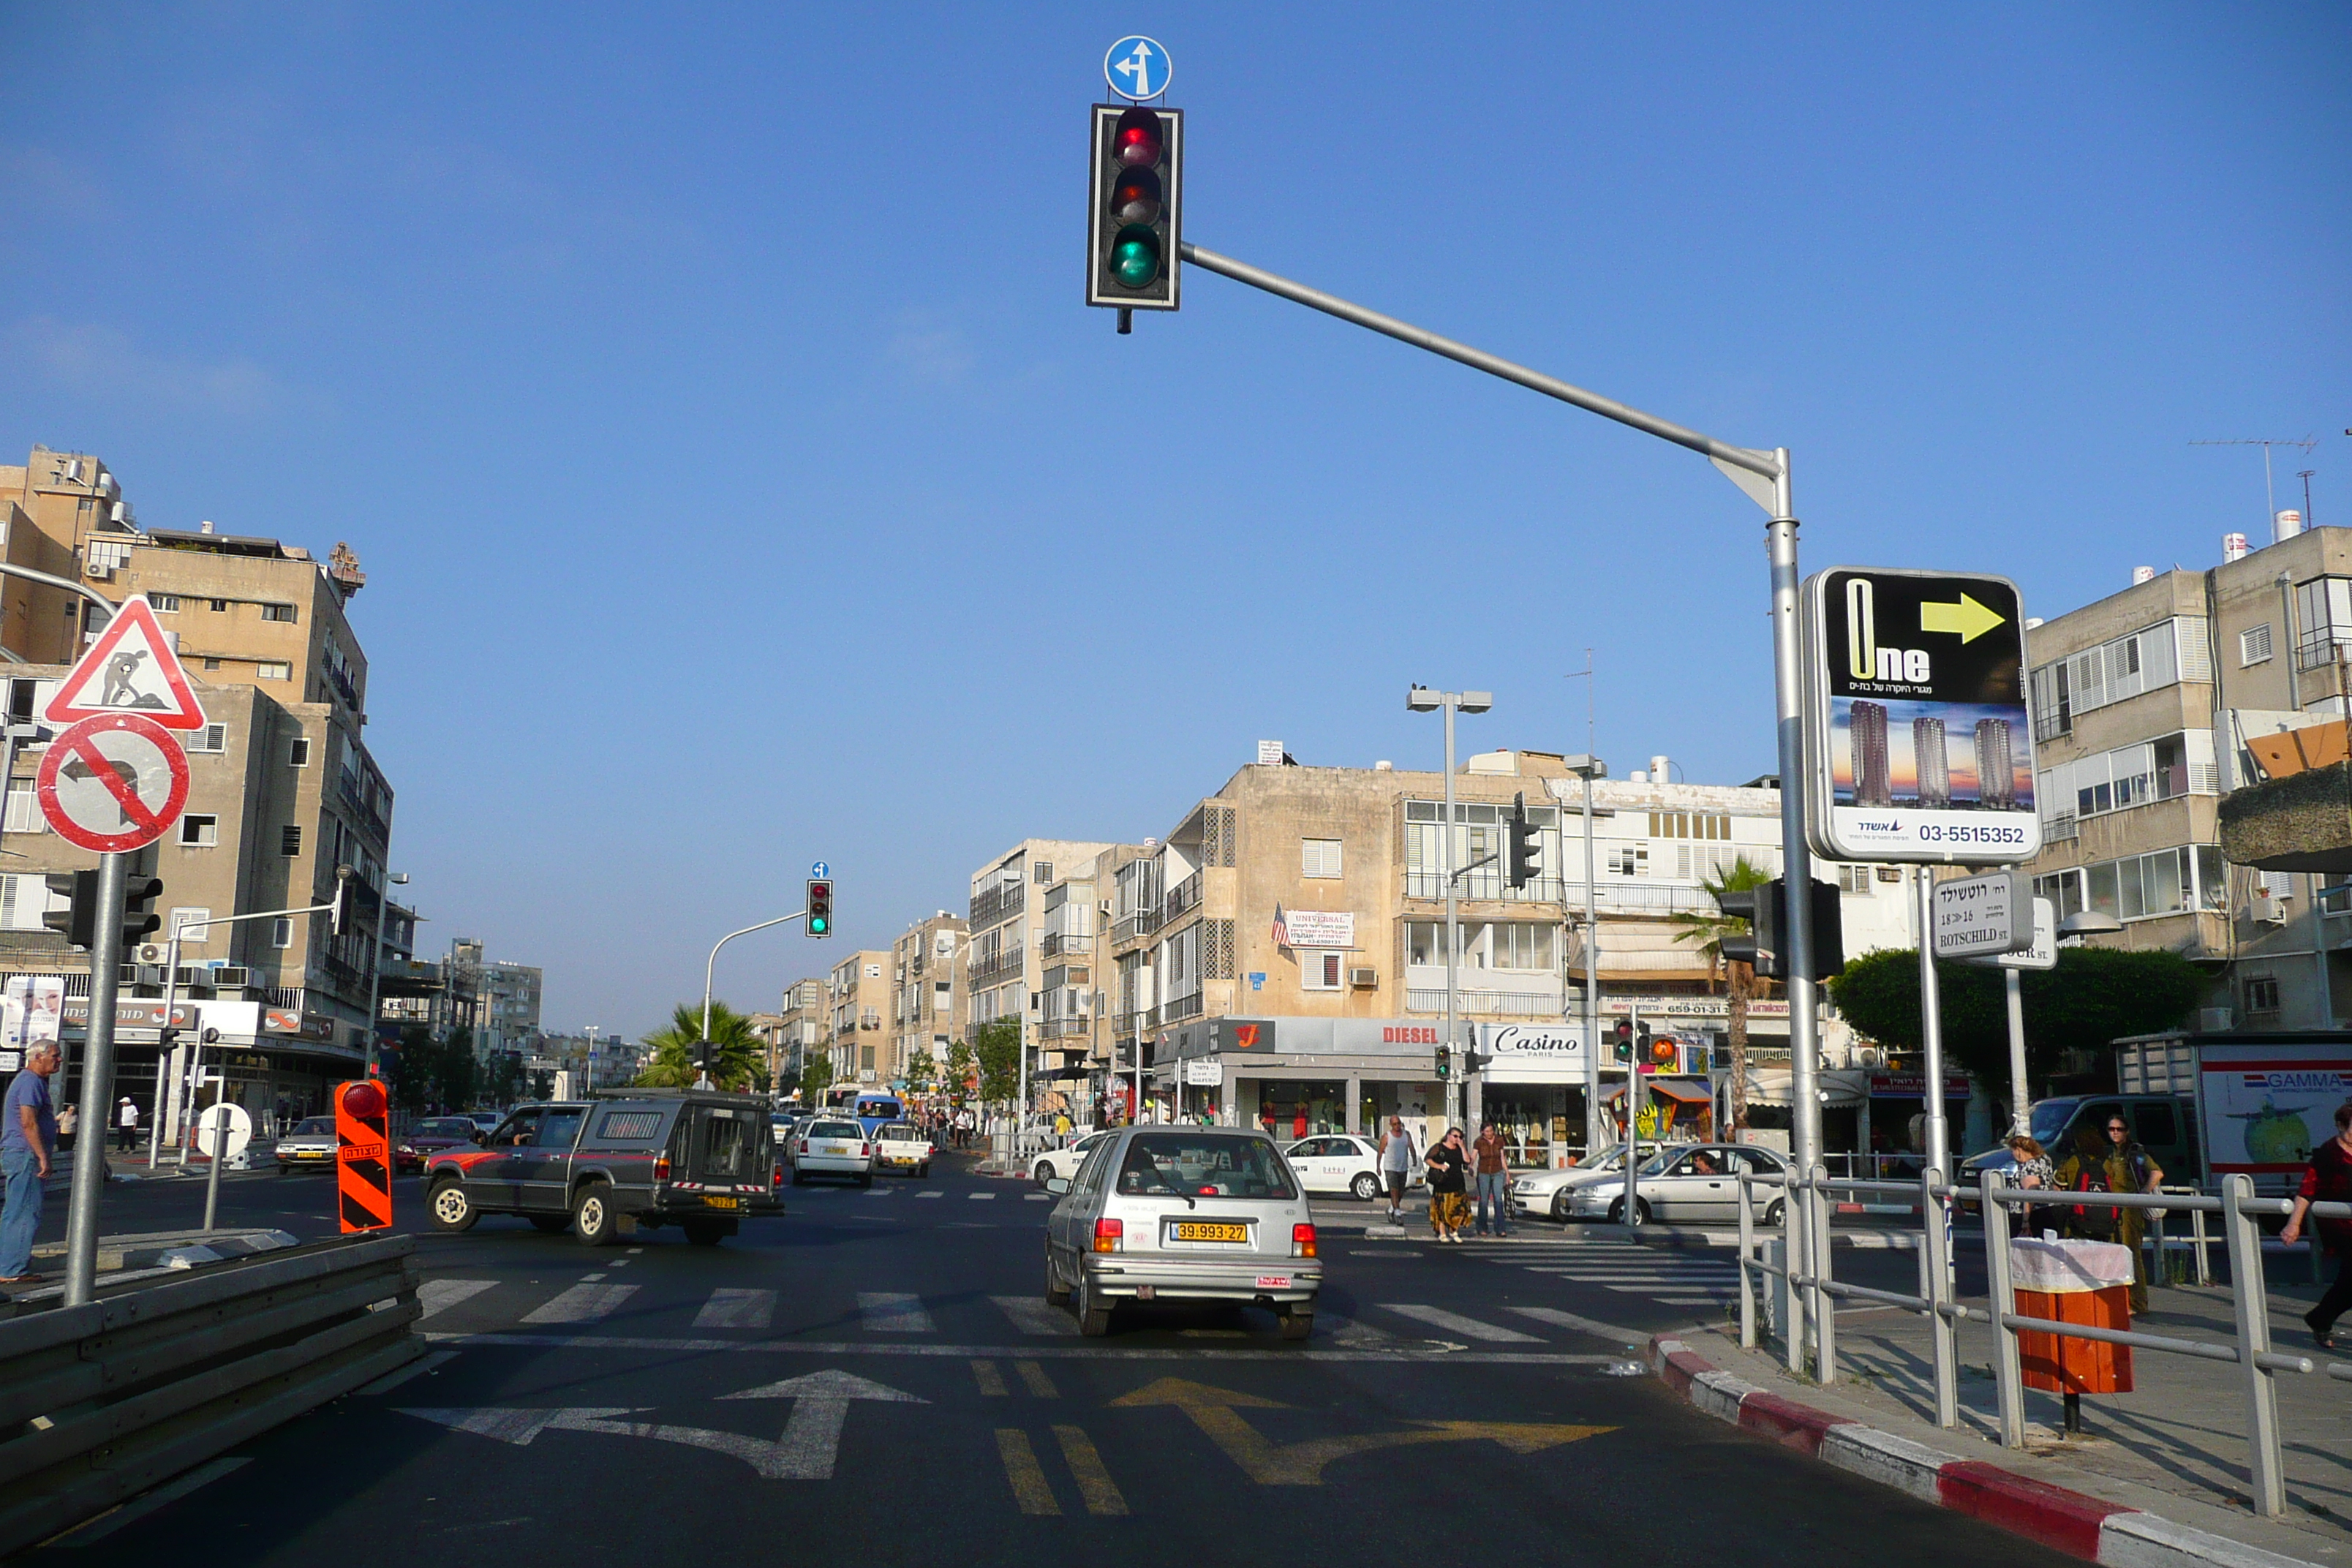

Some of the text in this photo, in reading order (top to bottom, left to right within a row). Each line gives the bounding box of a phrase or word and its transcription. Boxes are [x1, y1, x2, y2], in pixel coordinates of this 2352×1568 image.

[1846, 578, 1930, 684] One
[1849, 681, 1932, 695] מגורי היוקרה של בת-ים
[1858, 822, 1890, 832] אשדר
[1919, 824, 2024, 844] 03-5515352
[1940, 883, 1988, 904] רוטשילד
[1295, 914, 1346, 924] UNIVERSAL
[1940, 928, 1997, 948] ROTSCHILD
[1382, 1026, 1439, 1044] DIESEL
[1494, 1025, 1578, 1053] Casino
[2268, 1074, 2342, 1088] GAMMA
